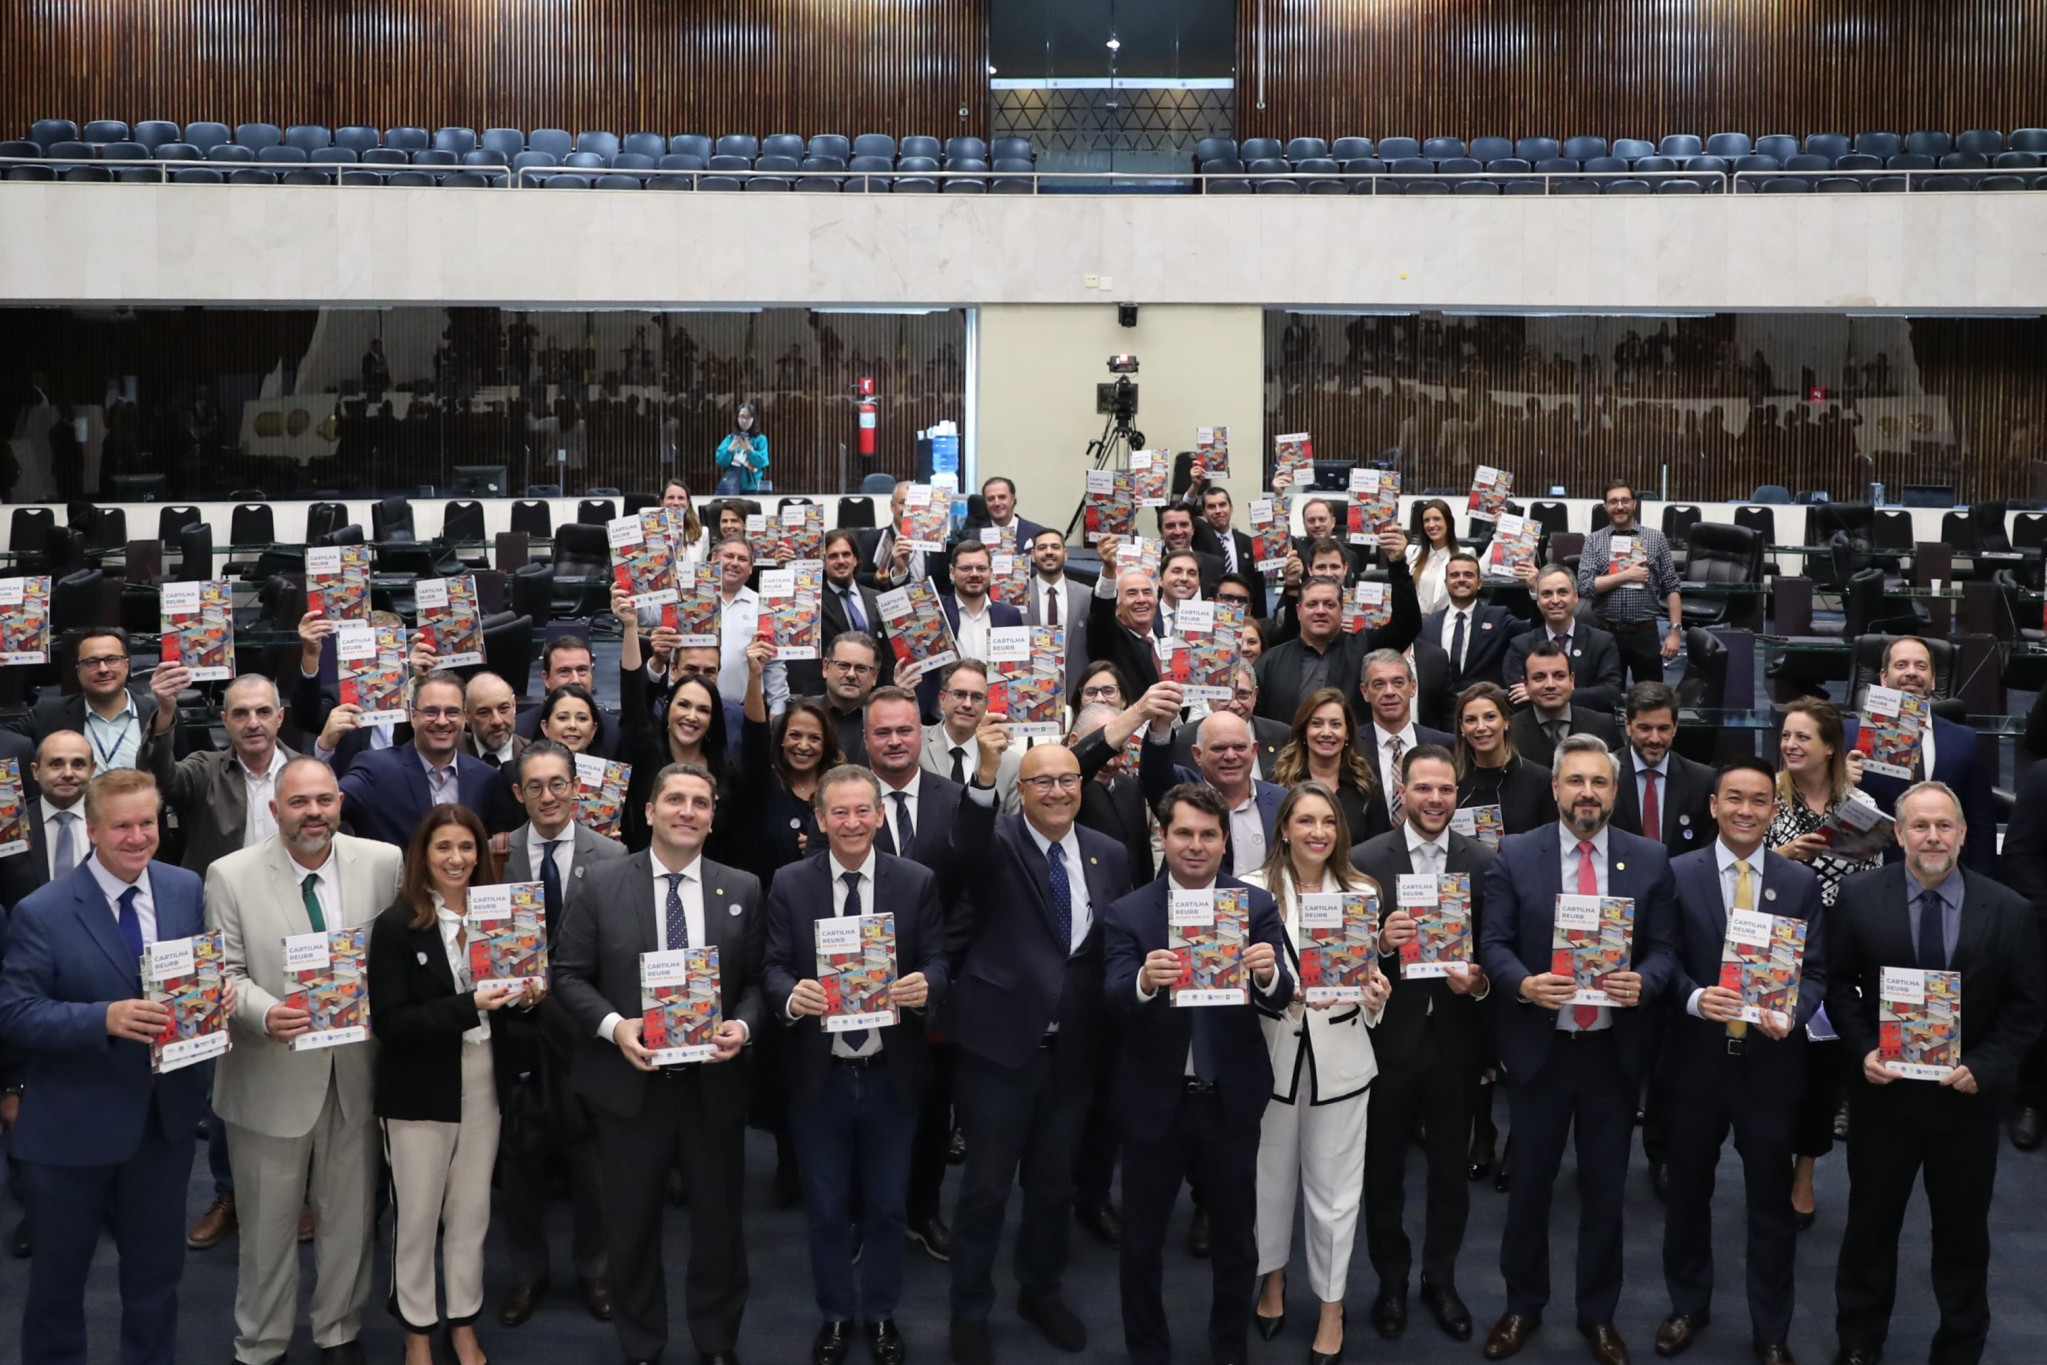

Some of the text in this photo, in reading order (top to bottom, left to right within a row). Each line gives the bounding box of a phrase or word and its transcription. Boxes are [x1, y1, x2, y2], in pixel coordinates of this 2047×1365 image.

[612, 525, 637, 534] CARTILHA
[881, 596, 904, 607] CARTILHA
[1871, 693, 1897, 703] CARTILHA
[1562, 906, 1595, 914] CARTILHA
[1734, 920, 1767, 930] CARTILHA
[1733, 927, 1755, 935] REURB
[289, 944, 324, 953] CARTILHA
[154, 951, 188, 962] CARTILHA
[155, 960, 179, 969] REURB
[647, 962, 680, 970] CARTILHA
[1886, 978, 1920, 986] CARTILHA
